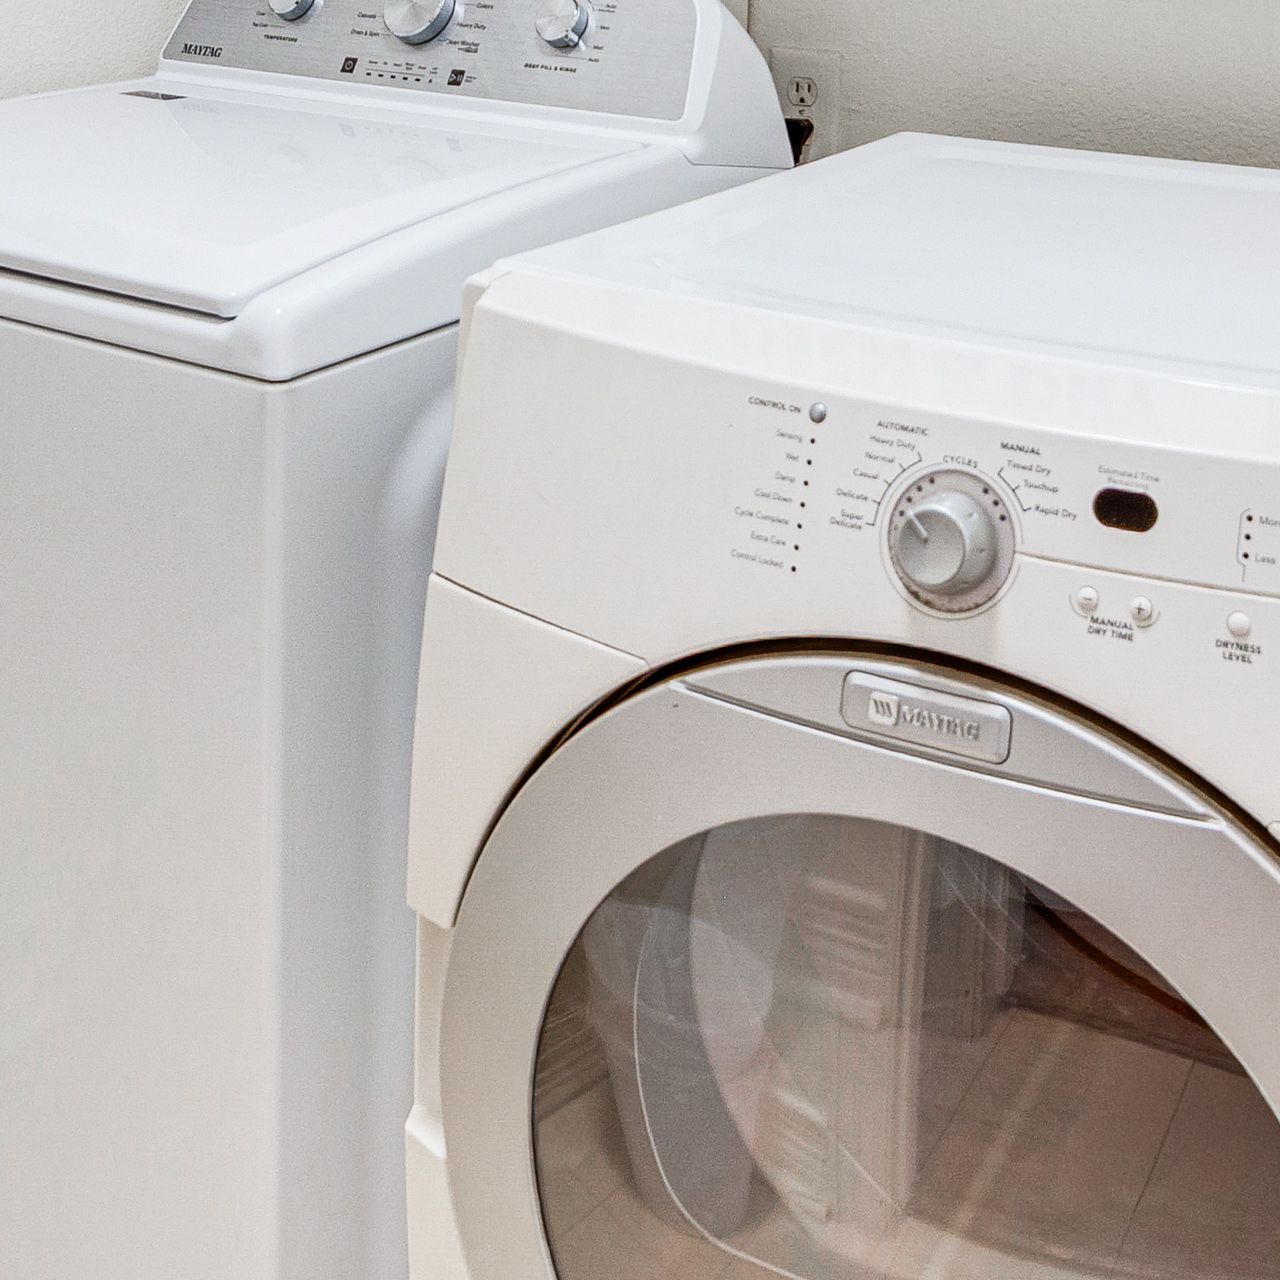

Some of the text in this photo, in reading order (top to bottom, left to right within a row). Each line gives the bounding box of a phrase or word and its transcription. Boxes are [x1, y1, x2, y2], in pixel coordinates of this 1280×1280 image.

[181, 43, 222, 57] MAYTAG
[748, 396, 787, 411] CONTROL
[877, 420, 929, 436] AUTOMATIC
[870, 435, 916, 451] Heavy Duty
[1000, 442, 1041, 456] MANUAL
[865, 452, 896, 464] Normal
[943, 454, 979, 469] CYCLES
[853, 468, 879, 480] Casual
[1007, 459, 1051, 477] Timed Dry
[836, 488, 868, 502] Delicate
[841, 509, 864, 521] Super
[1035, 504, 1078, 521] Rapid Dry
[830, 516, 862, 530] Delicate
[1255, 552, 1276, 565] Less
[1090, 615, 1134, 631] MANUAL
[1087, 625, 1134, 642] DRY TIME
[1215, 638, 1262, 655] DRYNESS
[1222, 652, 1253, 665] LEVEL
[900, 704, 980, 740] MAYTAG
